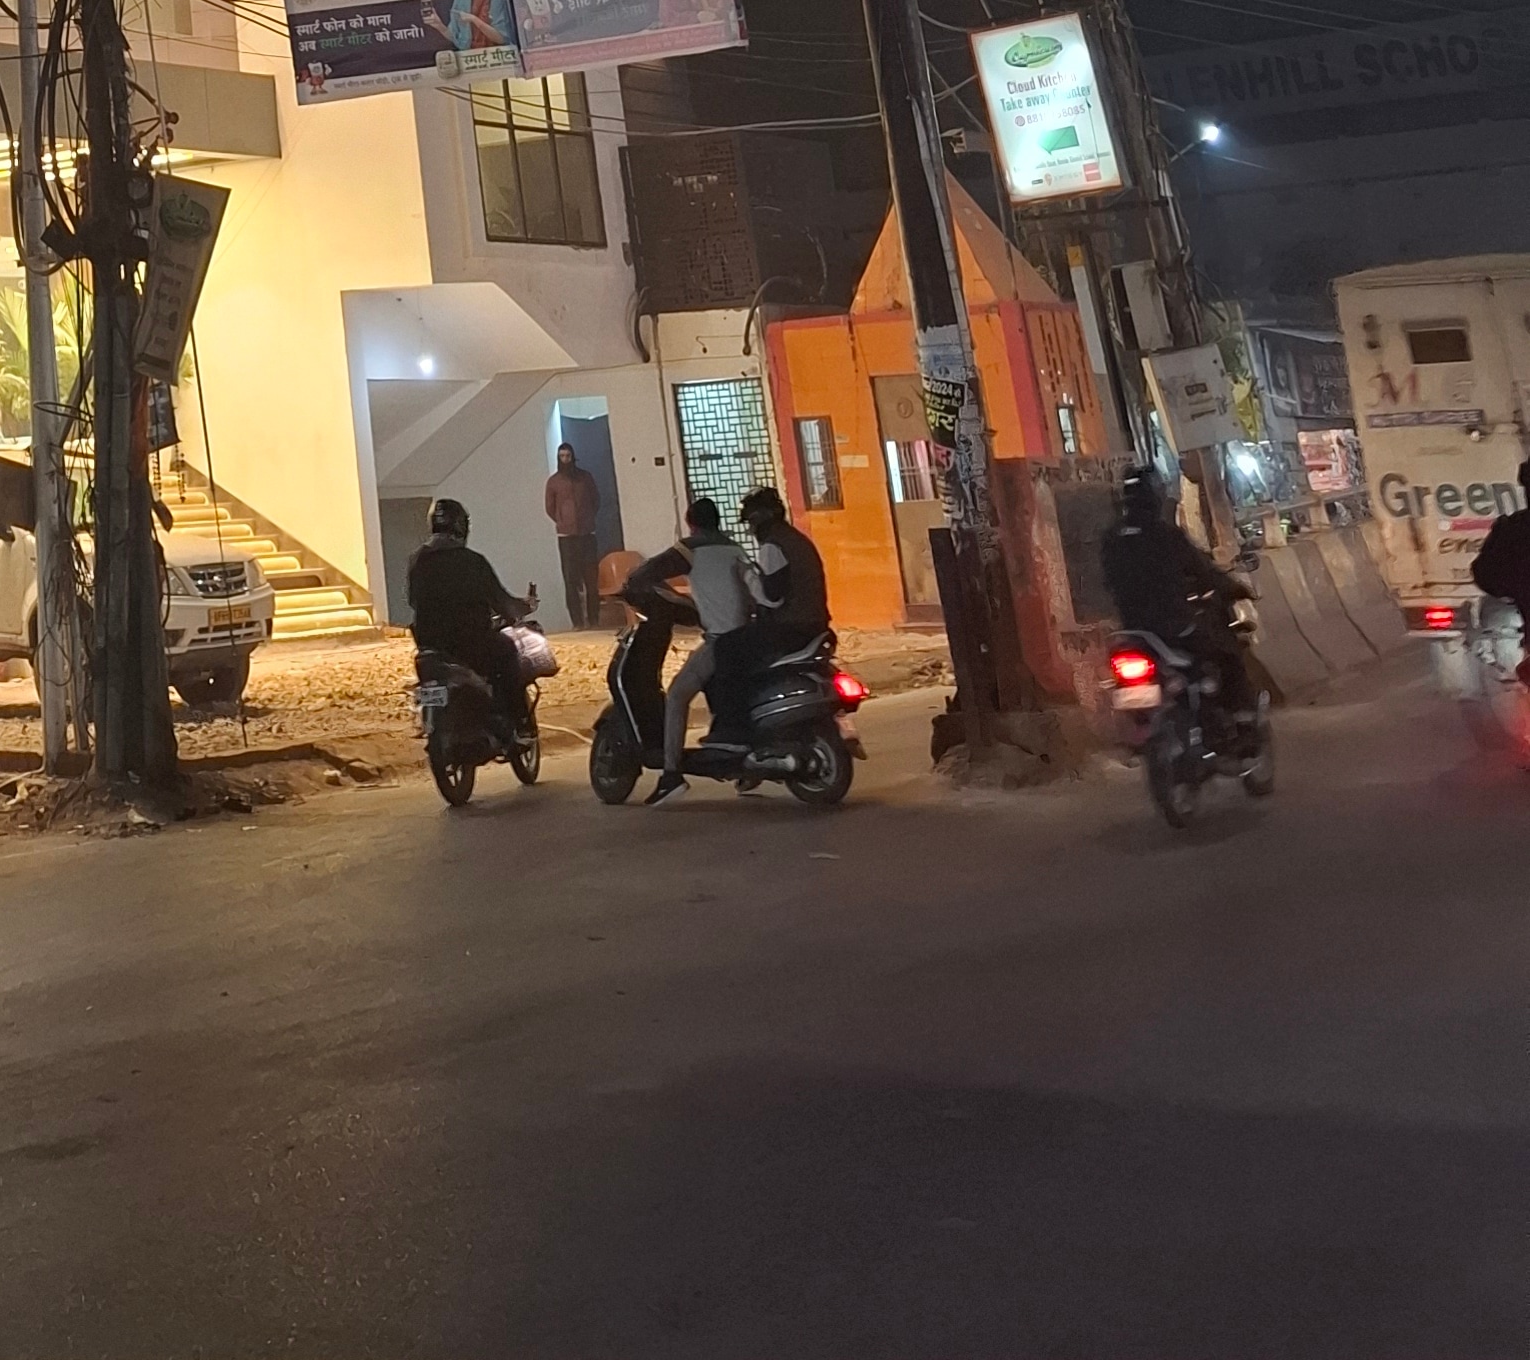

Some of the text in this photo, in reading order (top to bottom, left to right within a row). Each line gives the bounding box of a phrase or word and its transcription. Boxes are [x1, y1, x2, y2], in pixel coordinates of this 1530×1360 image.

[295, 14, 392, 36] स्मार्ट फोन को माना
[347, 31, 373, 46] मीटर
[375, 28, 390, 42] को
[1007, 71, 1077, 94] Cloud Kitchn
[1000, 97, 1024, 112] Take
[1026, 92, 1050, 108] away
[1380, 472, 1520, 518] Green
